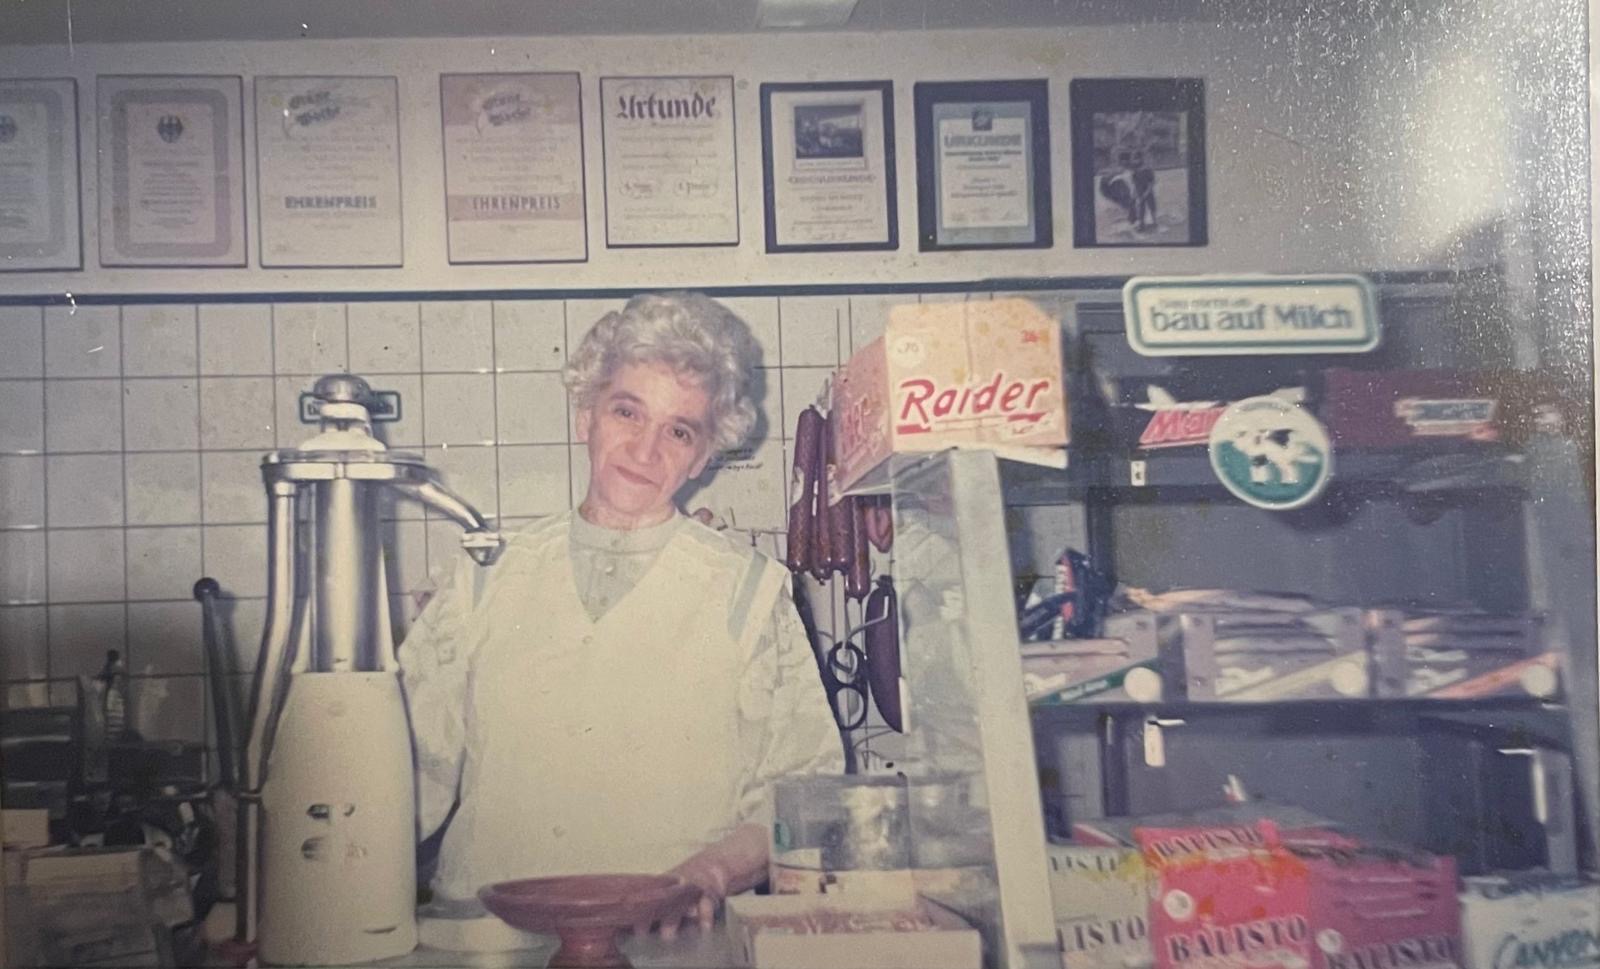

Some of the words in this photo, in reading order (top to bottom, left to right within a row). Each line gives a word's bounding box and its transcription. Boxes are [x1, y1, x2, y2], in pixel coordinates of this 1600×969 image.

[615, 92, 716, 119] Urkunde
[285, 196, 377, 208] EHRENPREIS
[472, 195, 561, 210] EHRENPREIS
[1150, 307, 1210, 331] bau
[1217, 304, 1266, 330] auf
[1275, 302, 1355, 329] Milch
[900, 373, 1050, 424] Raider
[1168, 915, 1308, 962] BALISTO
